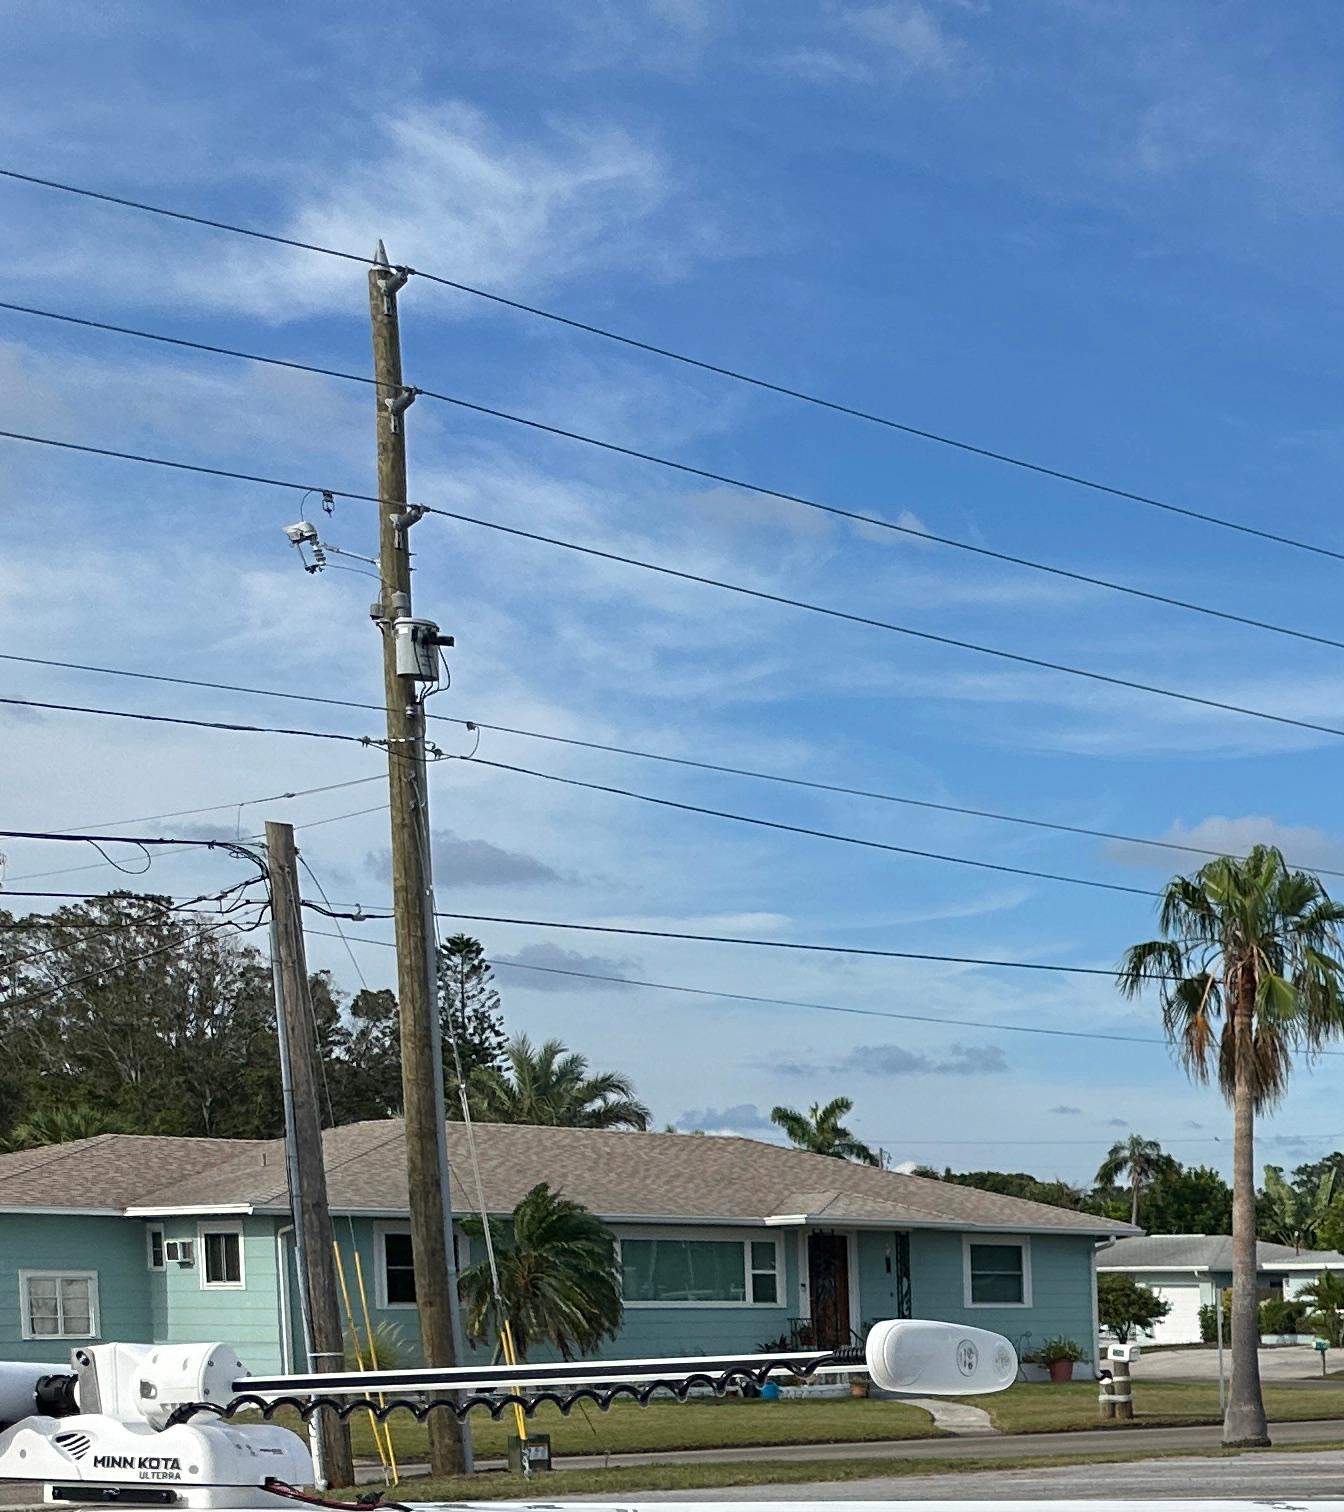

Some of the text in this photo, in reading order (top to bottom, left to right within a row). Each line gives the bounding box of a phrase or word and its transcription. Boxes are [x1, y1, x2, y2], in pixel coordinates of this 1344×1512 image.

[93, 1455, 181, 1470] MINN KOTA
[139, 1470, 181, 1480] ULTERRA
